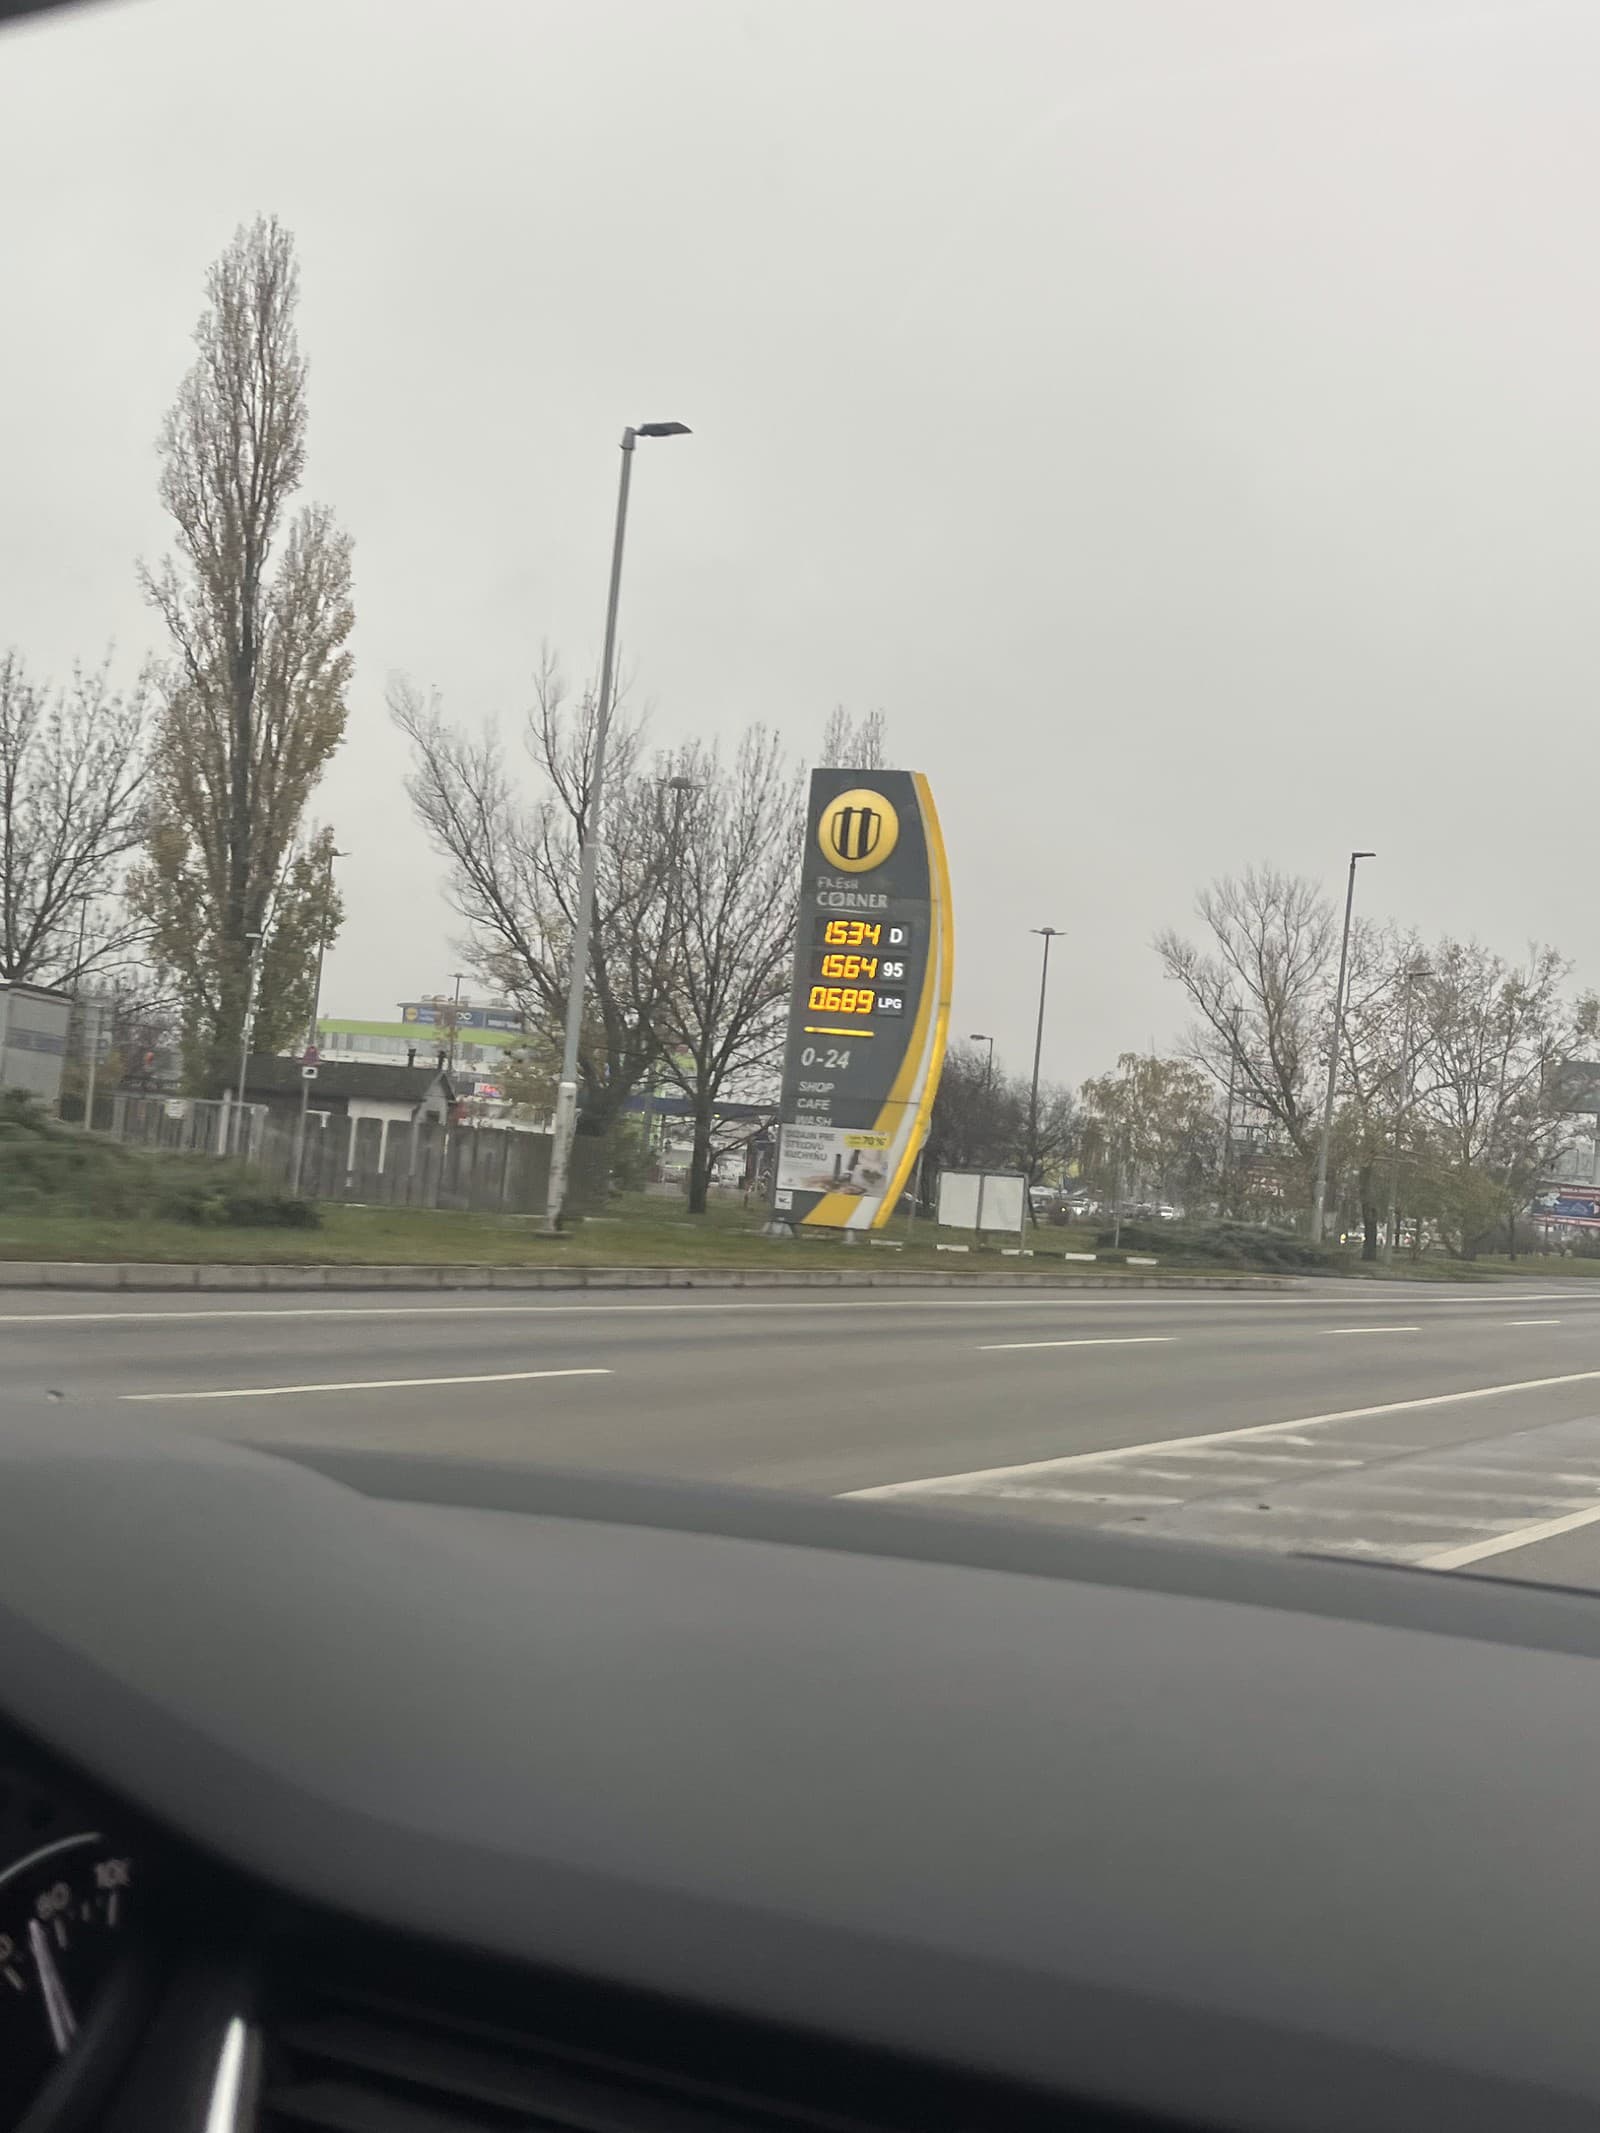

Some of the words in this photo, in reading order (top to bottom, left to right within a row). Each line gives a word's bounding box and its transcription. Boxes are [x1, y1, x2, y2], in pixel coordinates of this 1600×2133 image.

[816, 892, 888, 908] CORNER
[824, 920, 882, 946] 1534
[889, 927, 903, 943] D
[821, 954, 878, 979] 1564
[883, 961, 904, 977] 95
[808, 986, 875, 1014] 0689
[878, 997, 902, 1009] LPG
[801, 1047, 850, 1069] 0-24
[799, 1081, 835, 1093] SHOP
